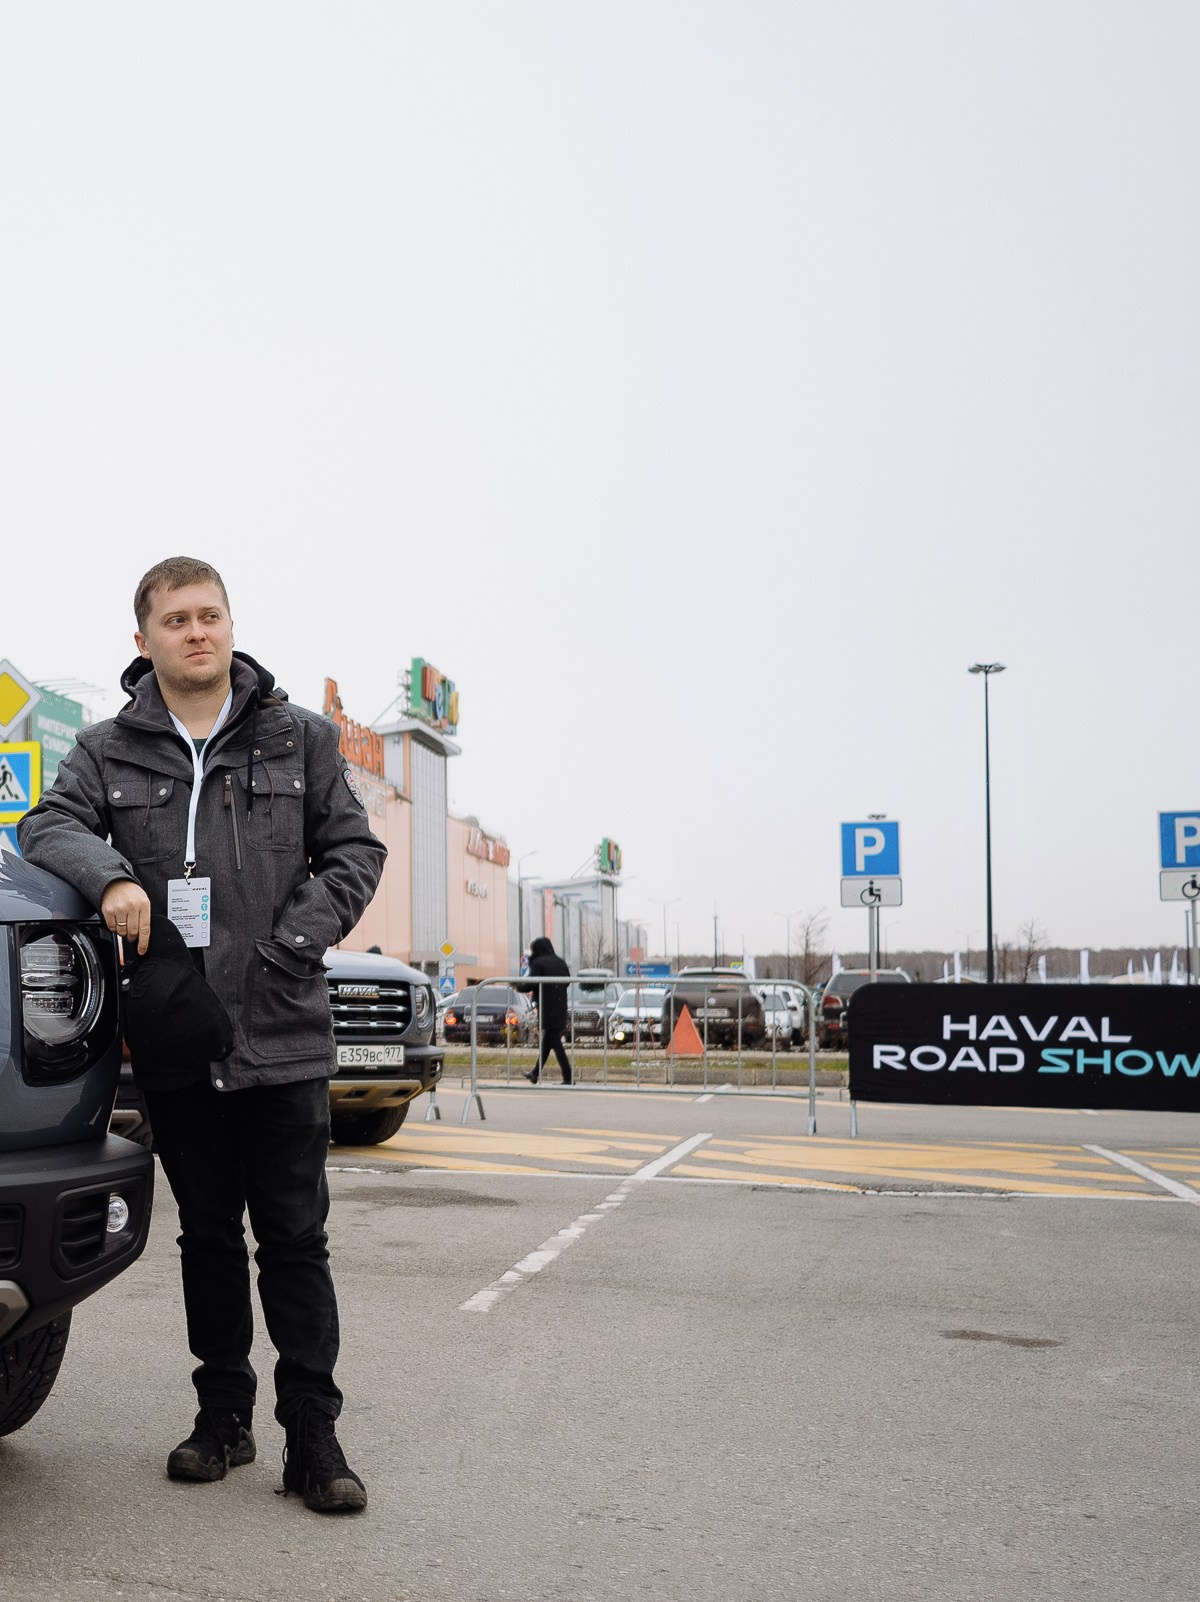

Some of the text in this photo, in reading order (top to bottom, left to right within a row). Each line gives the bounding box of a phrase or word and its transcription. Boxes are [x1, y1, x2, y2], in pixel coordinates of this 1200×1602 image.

[854, 828, 885, 871] P
[1174, 817, 1200, 863] P
[342, 987, 377, 996] HAVAL
[942, 1014, 1132, 1044] HAVAL
[385, 1047, 401, 1058] 977
[872, 1044, 1200, 1077] ROAD SHOW
